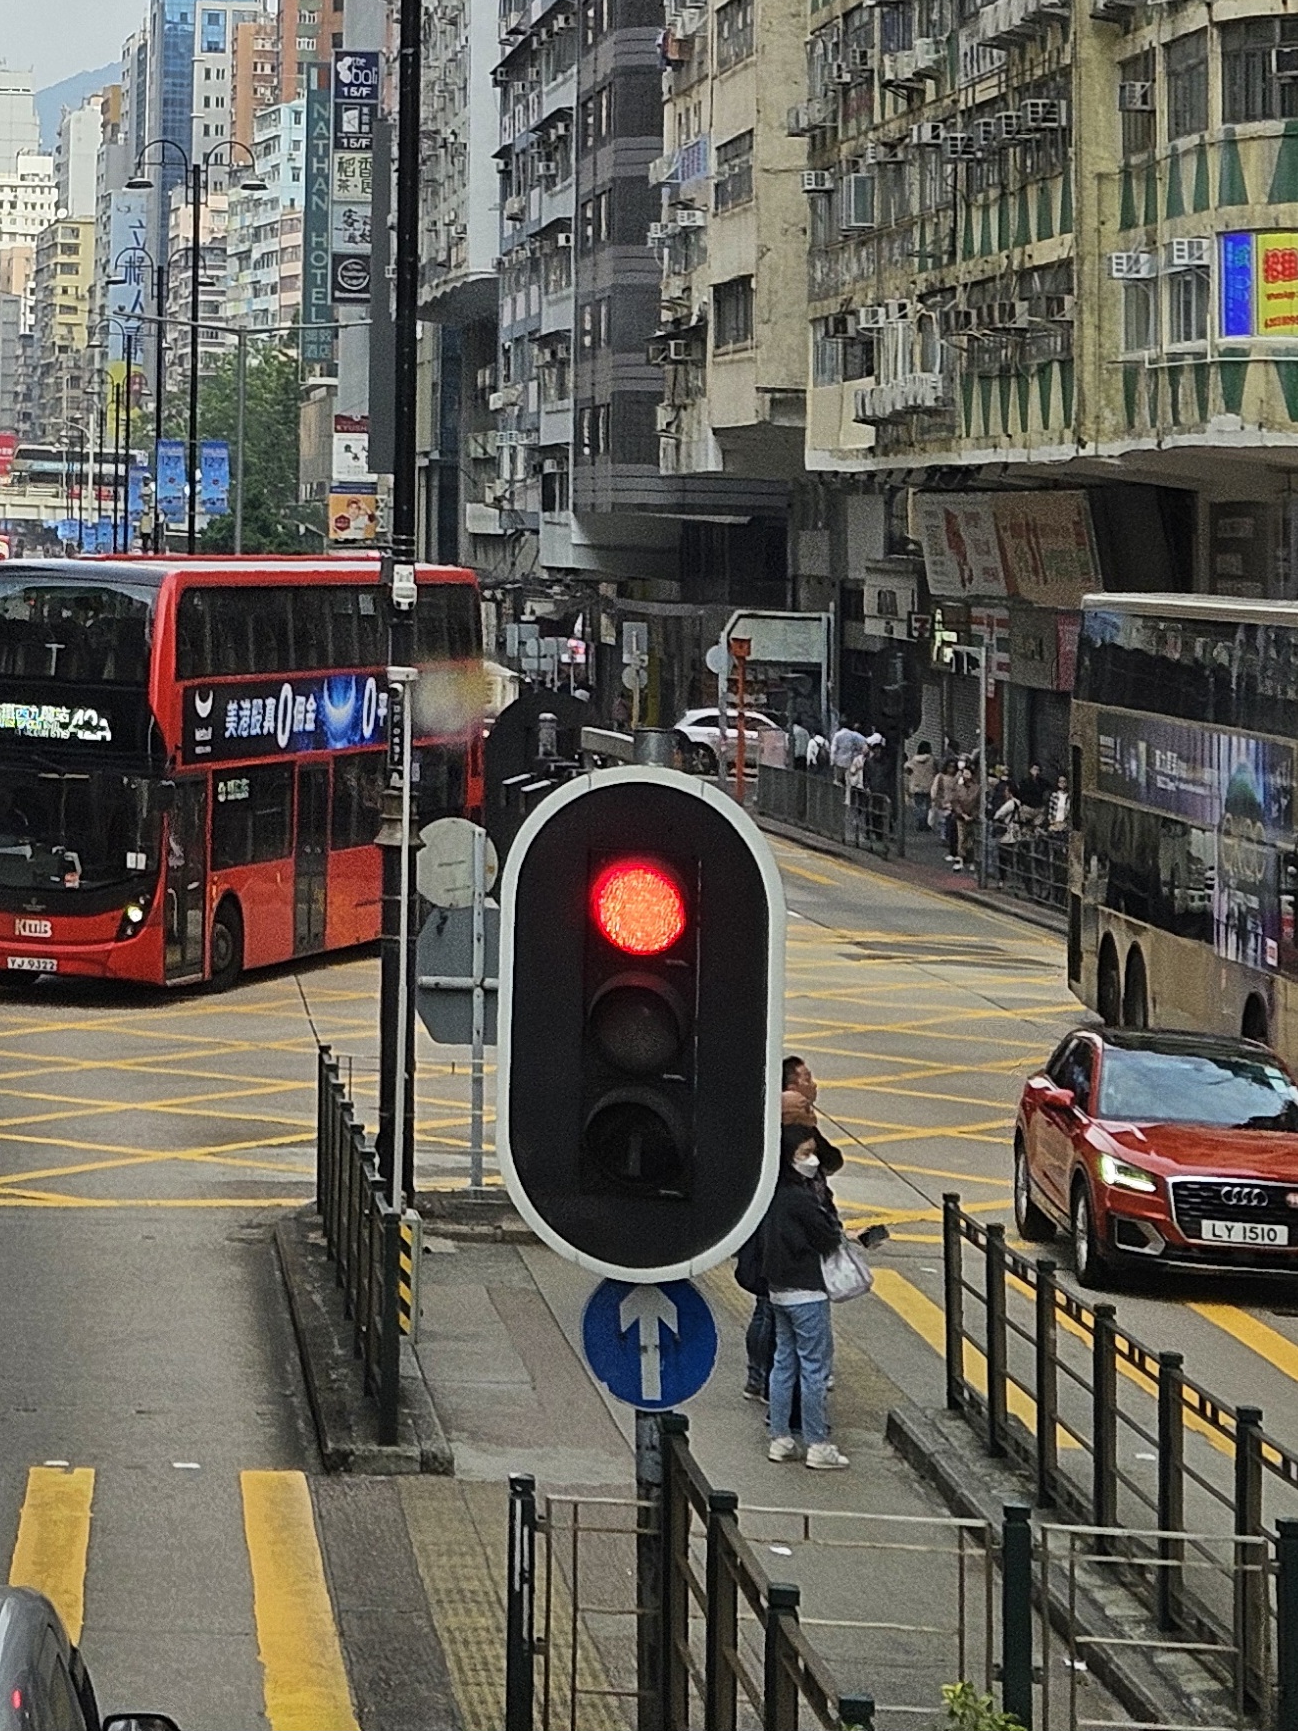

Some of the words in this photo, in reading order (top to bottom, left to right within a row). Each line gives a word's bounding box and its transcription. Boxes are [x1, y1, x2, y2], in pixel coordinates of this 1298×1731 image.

[342, 86, 372, 98] 15/F
[342, 138, 371, 149] 15/F
[311, 102, 331, 211] NATHAN
[310, 232, 328, 323] HOTEL
[14, 918, 52, 938] KMB
[1212, 1223, 1235, 1239] LY
[1242, 1225, 1278, 1242] 1510
